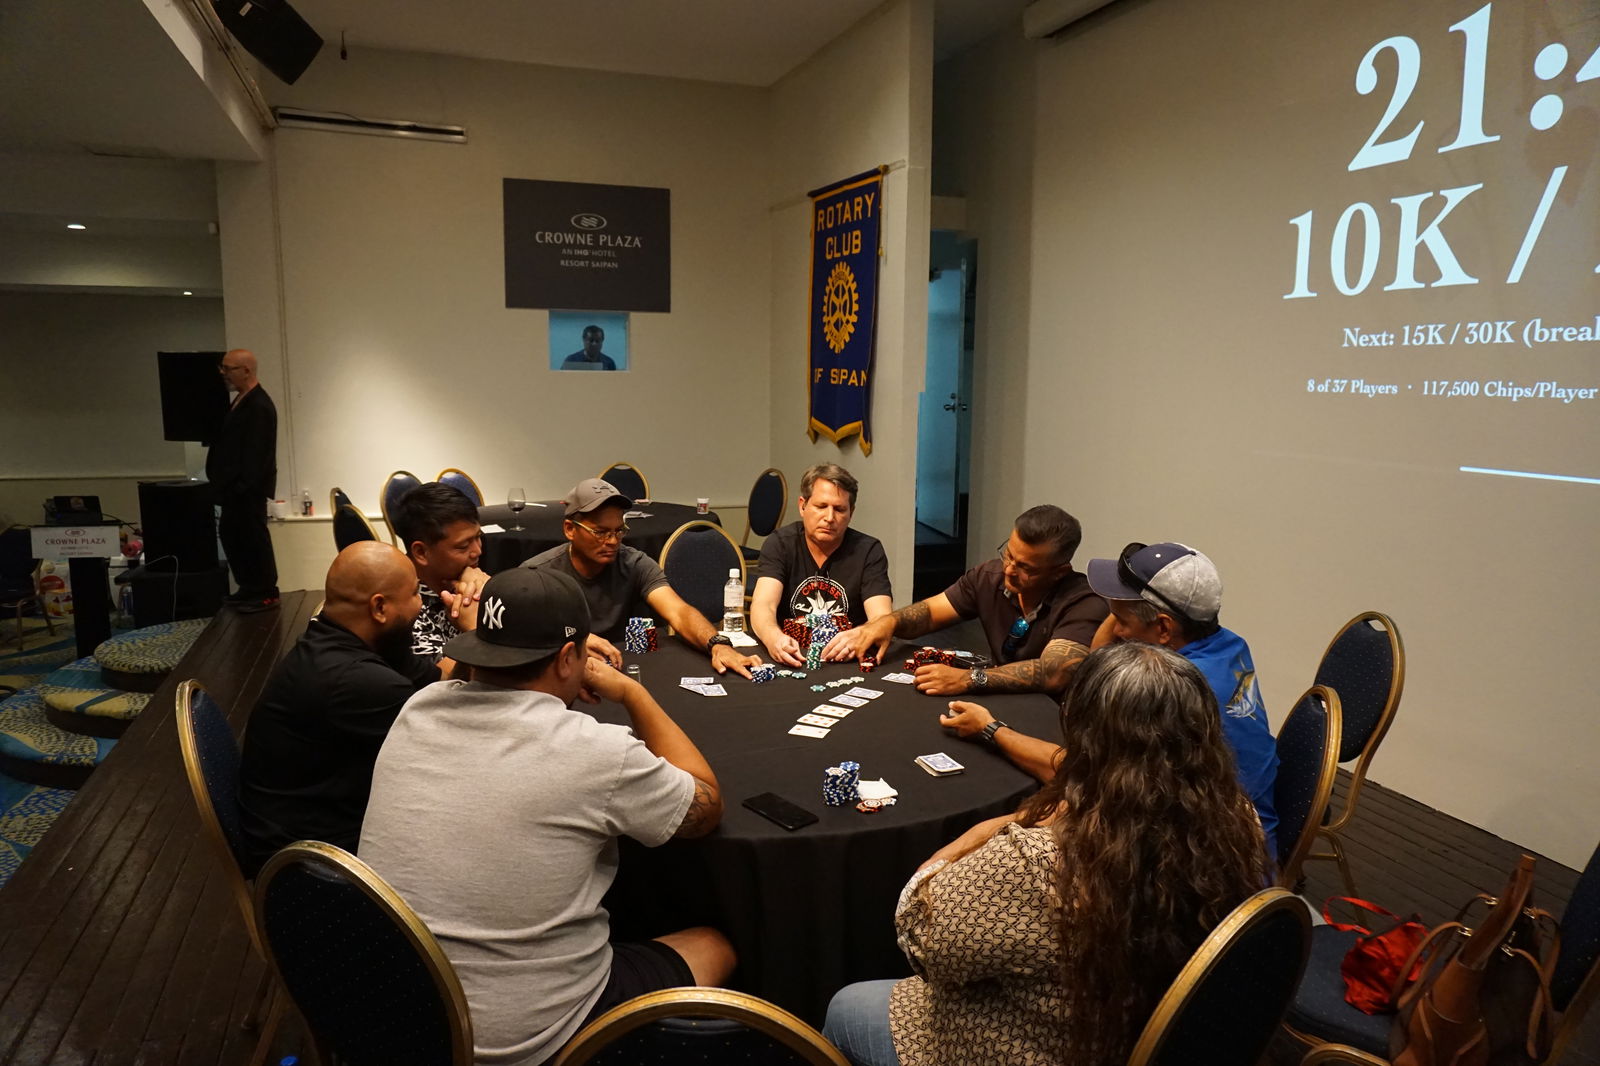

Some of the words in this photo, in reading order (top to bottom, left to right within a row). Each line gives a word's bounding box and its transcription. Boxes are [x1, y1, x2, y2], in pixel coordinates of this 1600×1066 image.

[1348, 2, 1600, 171] 21:
[817, 192, 875, 232] ROTARY
[535, 231, 593, 246] CROWNE
[599, 234, 642, 248] PLAZA
[825, 229, 861, 260] CLUB
[1283, 183, 1483, 300] 10K
[560, 259, 589, 267] RESORT
[1342, 328, 1394, 347] Next:
[1401, 323, 1446, 346] 15K
[1464, 320, 1516, 345] 30K
[1307, 378, 1315, 393] 8
[1317, 378, 1332, 393] of
[1332, 379, 1348, 393] 37
[1350, 379, 1398, 398] Players
[1422, 381, 1479, 397] 117,500
[1484, 381, 1598, 404] Chips/Player
